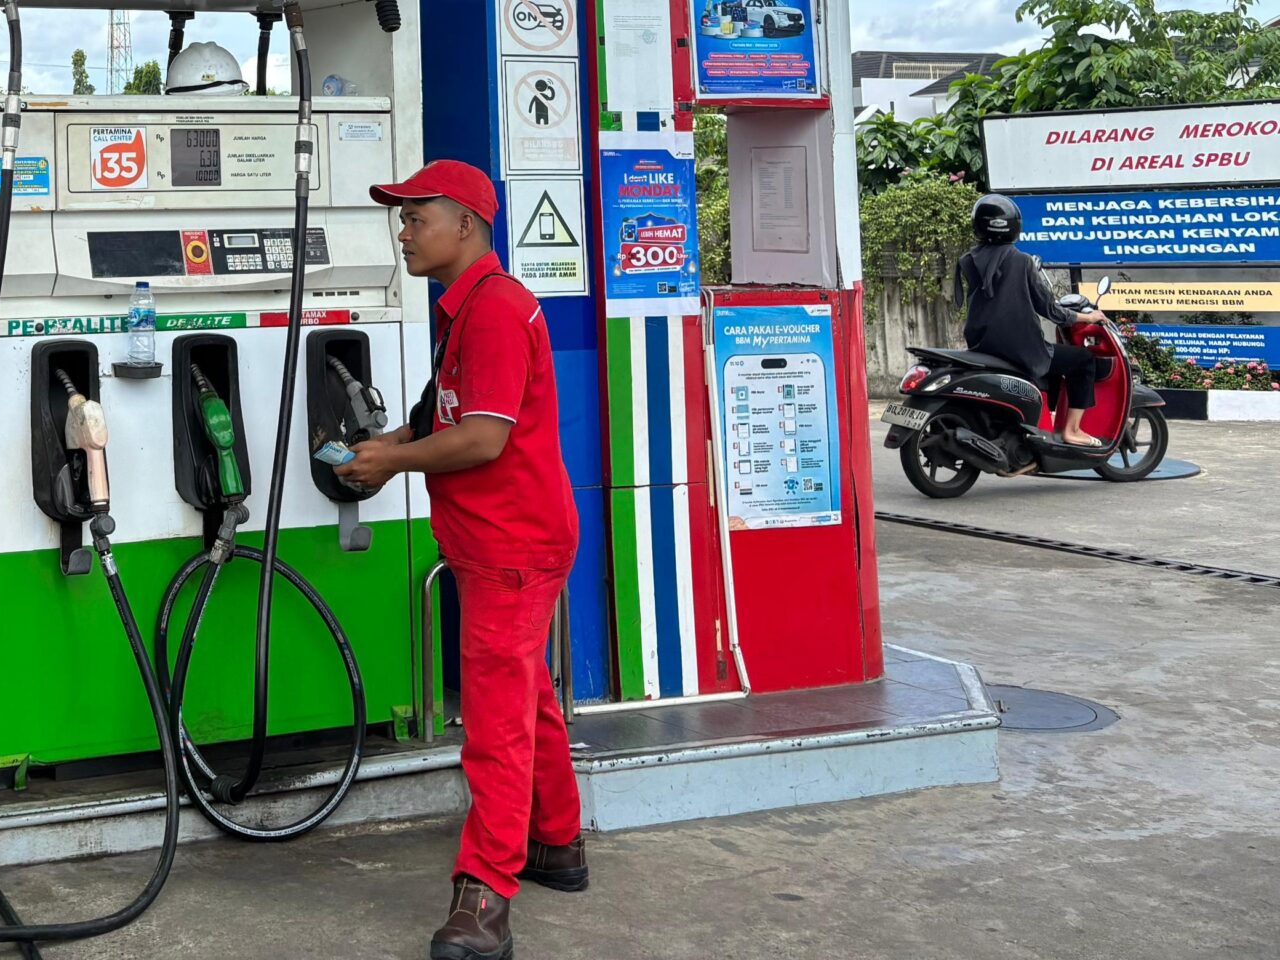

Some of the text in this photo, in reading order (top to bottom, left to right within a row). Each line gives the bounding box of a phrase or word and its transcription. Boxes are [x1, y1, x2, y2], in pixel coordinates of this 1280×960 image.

[109, 134, 133, 142] CENTER
[186, 130, 218, 147] 63000
[1045, 120, 1280, 145] DILARANG MEROKO
[93, 152, 138, 179] 135
[1091, 152, 1251, 171] DI AREAL SPBU
[649, 173, 675, 184] LIKE
[618, 184, 682, 198] MONDAY
[1046, 199, 1153, 211] MENJAGA
[1041, 211, 1280, 227] DAN KEINDAHAN LOK
[655, 228, 683, 238] HEMAT
[1019, 228, 1175, 242] MEWUJUDKAN
[630, 246, 678, 266] 300
[1103, 243, 1256, 255] LINGKUNGAN
[723, 324, 821, 335] CARA PAKAI E-VOUCHER
